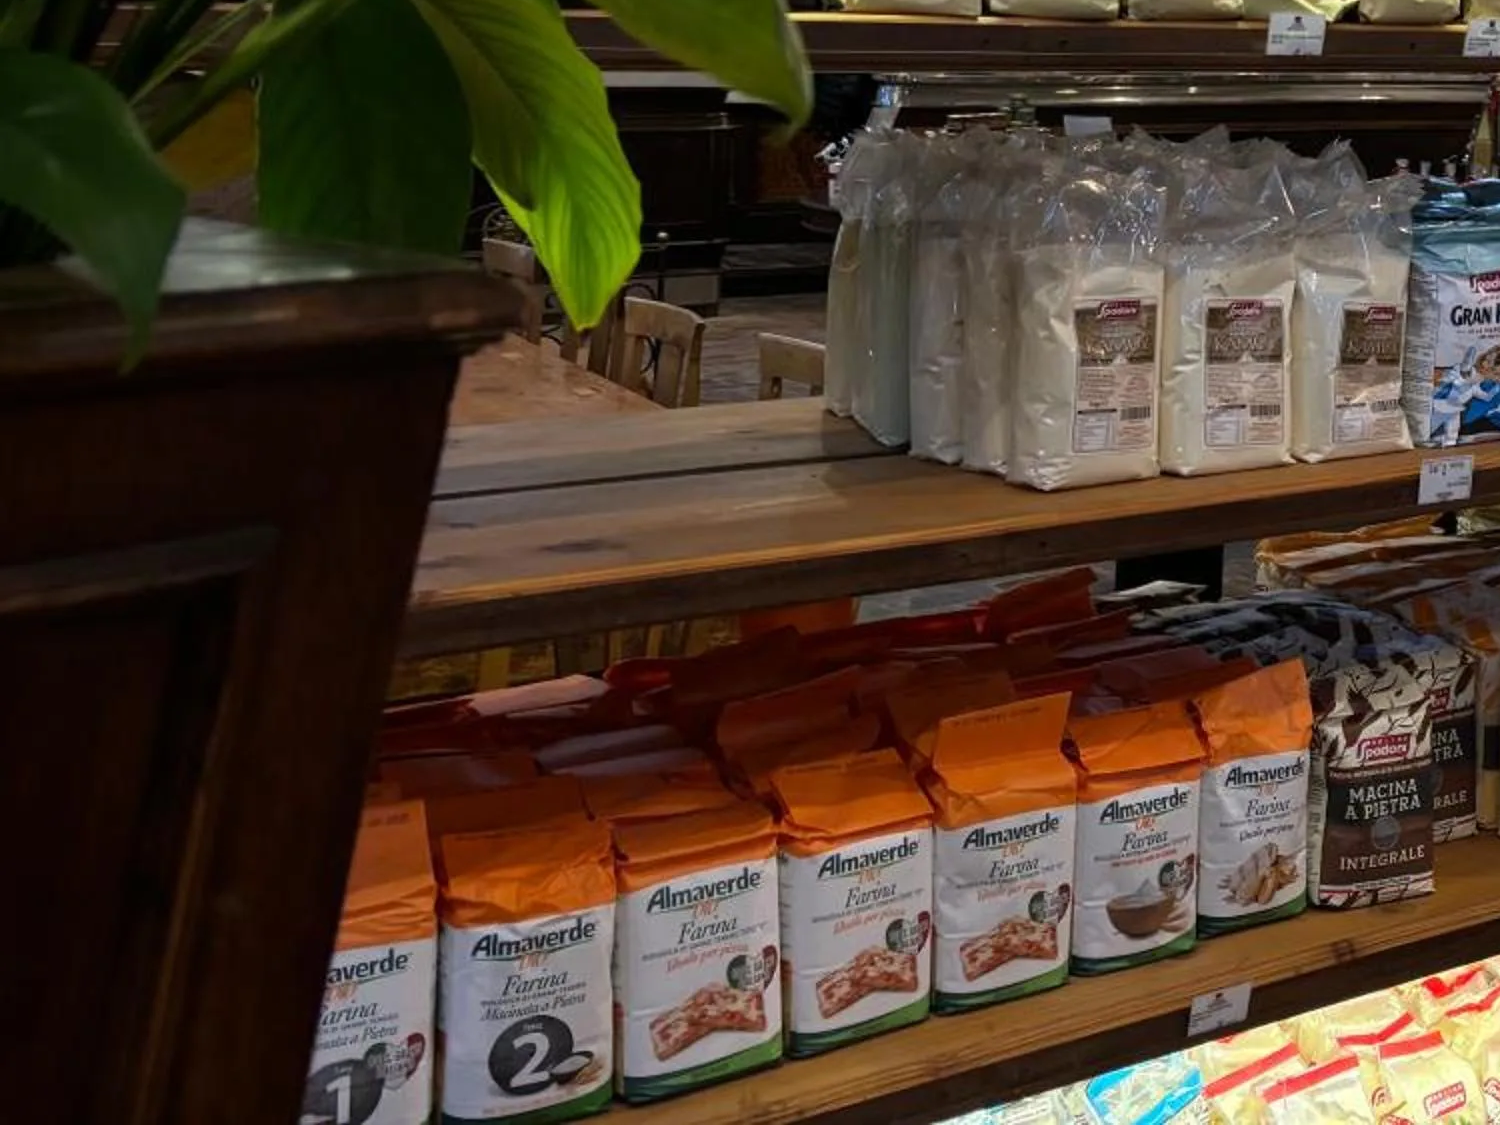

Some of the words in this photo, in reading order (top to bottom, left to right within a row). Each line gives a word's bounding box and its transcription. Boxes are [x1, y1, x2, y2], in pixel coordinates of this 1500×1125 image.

[1450, 305, 1492, 326] GRAN
[1359, 741, 1408, 765] Spadoni
[1099, 786, 1188, 822] Almaverde
[1348, 778, 1417, 804] MACINA
[1344, 804, 1359, 820] A
[1364, 794, 1421, 820] PIETRA
[962, 811, 1060, 849] Almaverde
[1121, 830, 1168, 852] Farina
[818, 836, 920, 879] Almaverde
[988, 857, 1040, 879] Farina
[1340, 844, 1425, 871] INTEGRALE
[645, 866, 761, 913] Almaverde
[844, 883, 897, 909] Farina
[470, 917, 596, 958] Almaverde
[678, 916, 738, 945] Farina
[502, 968, 569, 997] Farina
[509, 1031, 551, 1088] 2
